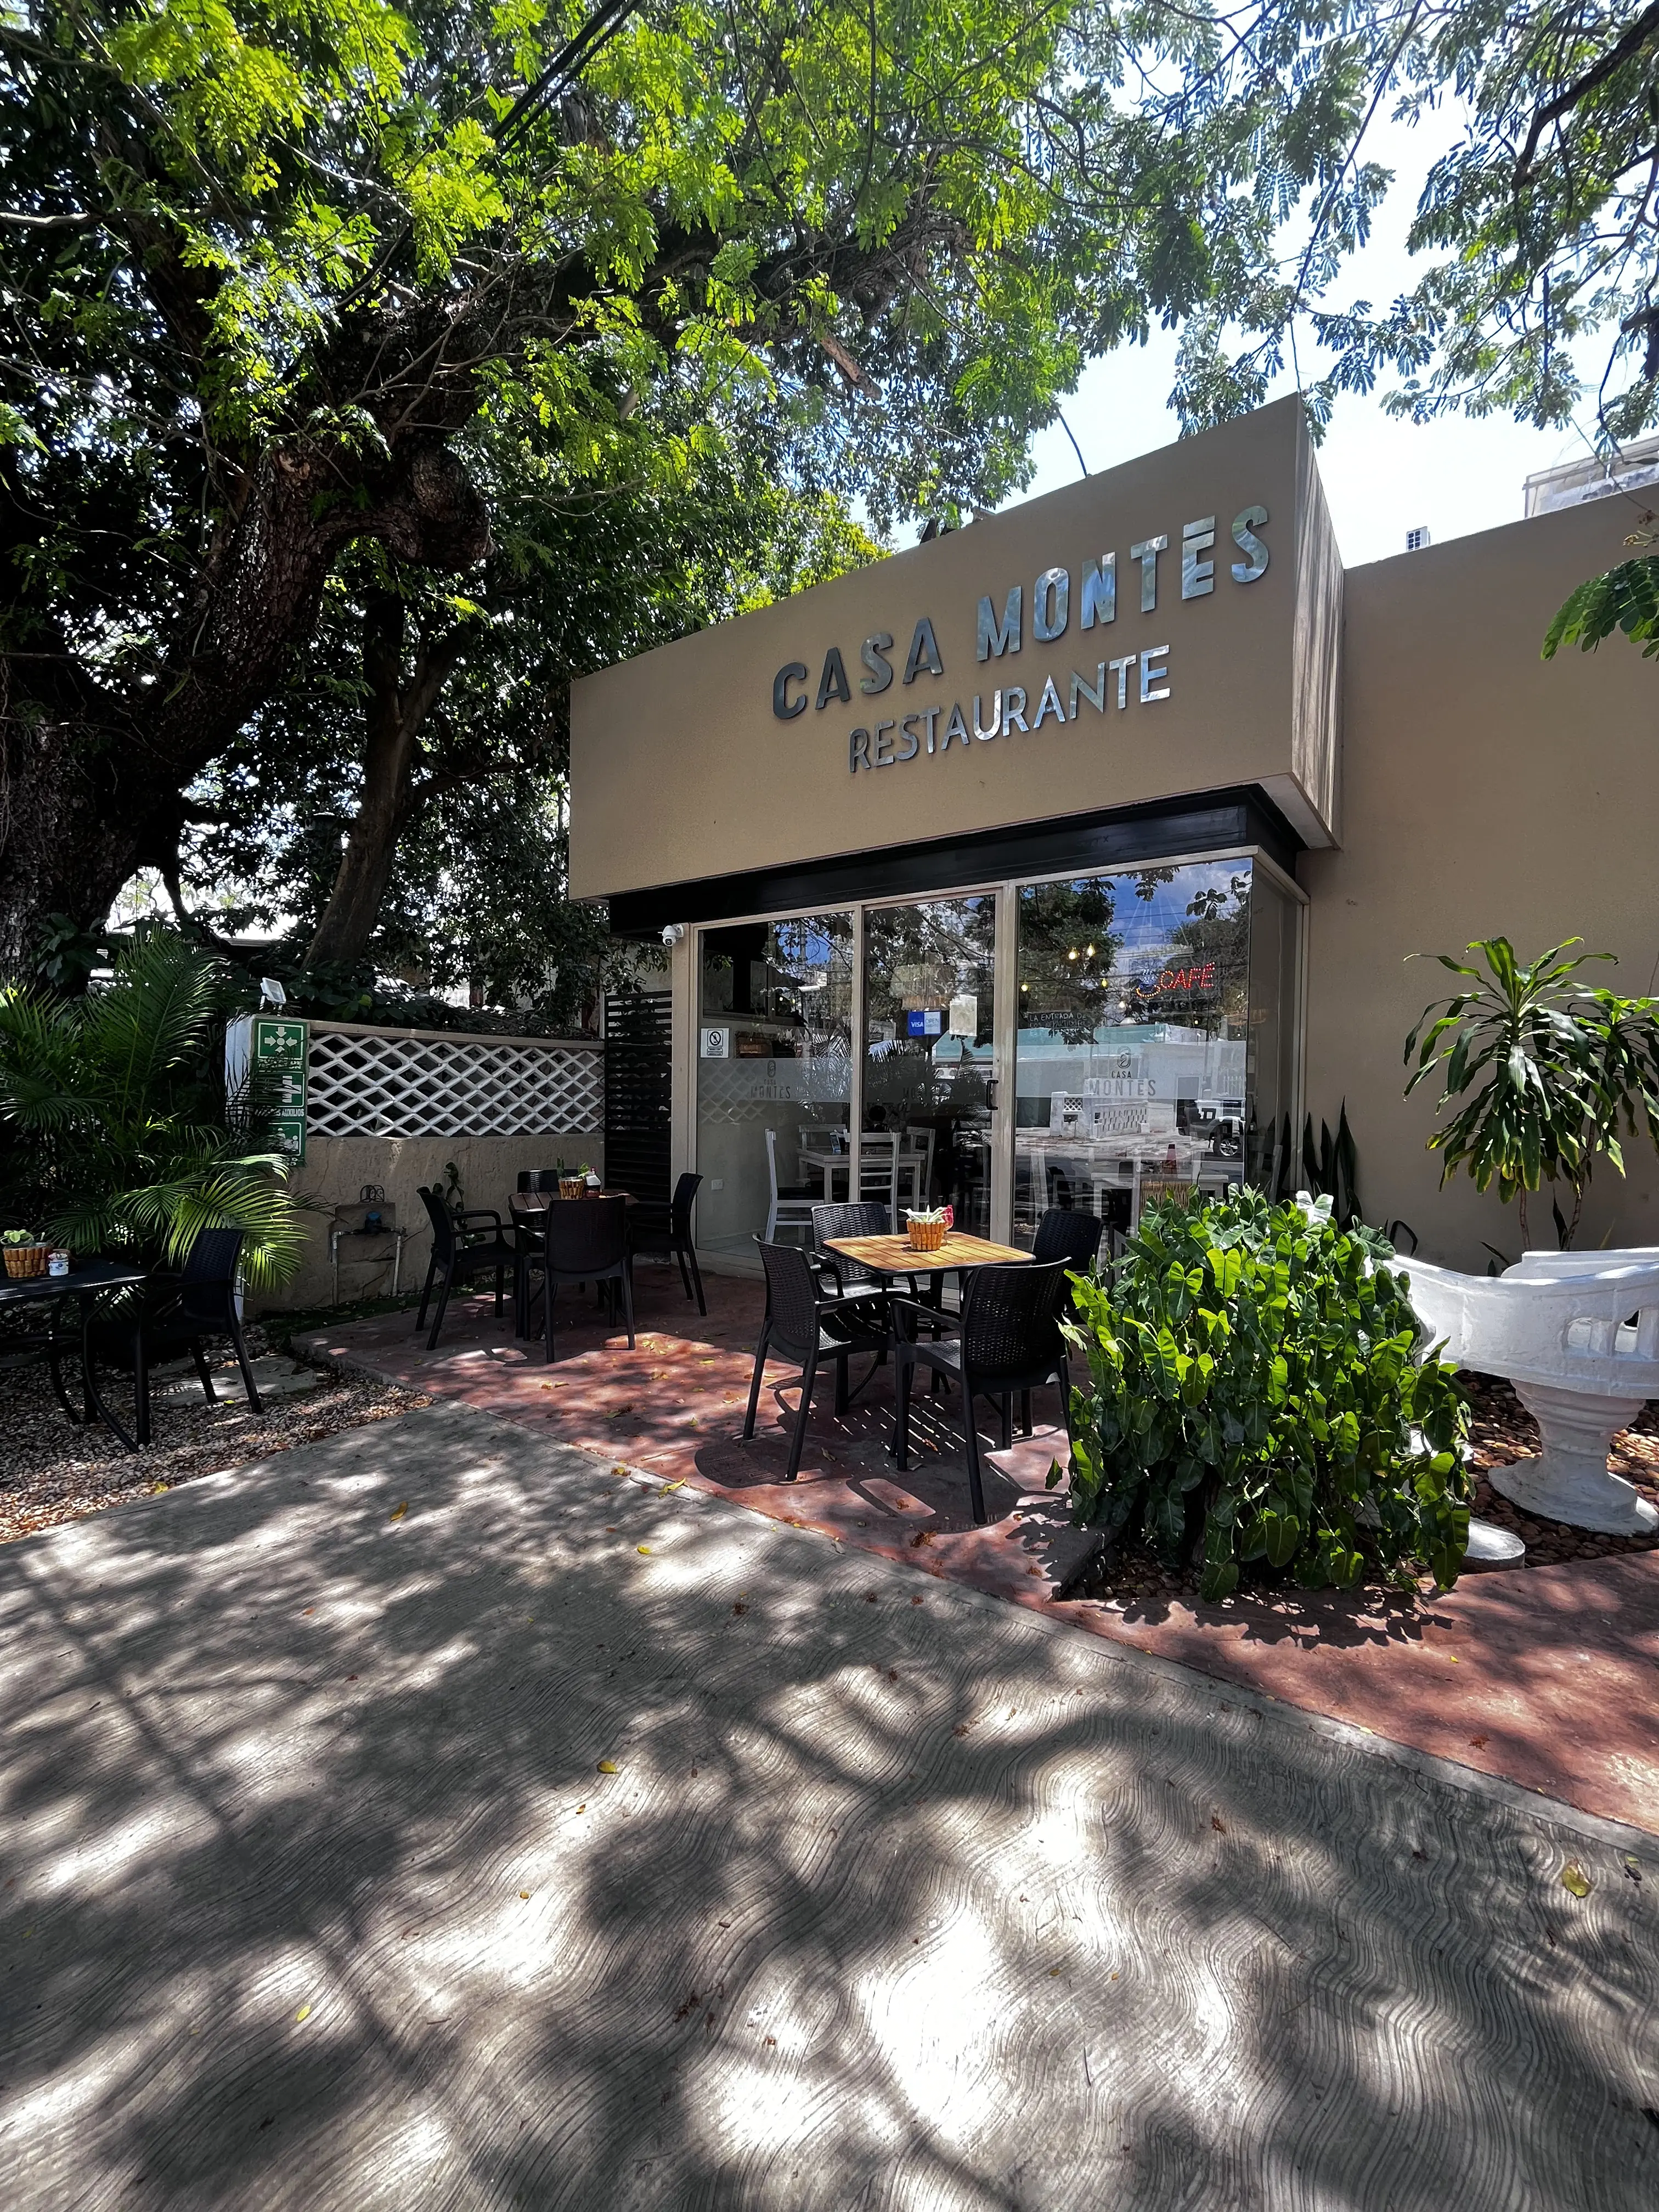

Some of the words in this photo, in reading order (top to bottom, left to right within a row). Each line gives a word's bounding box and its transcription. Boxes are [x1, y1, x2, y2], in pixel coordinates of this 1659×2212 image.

[772, 617, 943, 719] CASA
[849, 644, 1171, 772] RESTAURANTE
[1160, 961, 1215, 989] CAFÉ
[1041, 1012, 1074, 1021] ENTRADA
